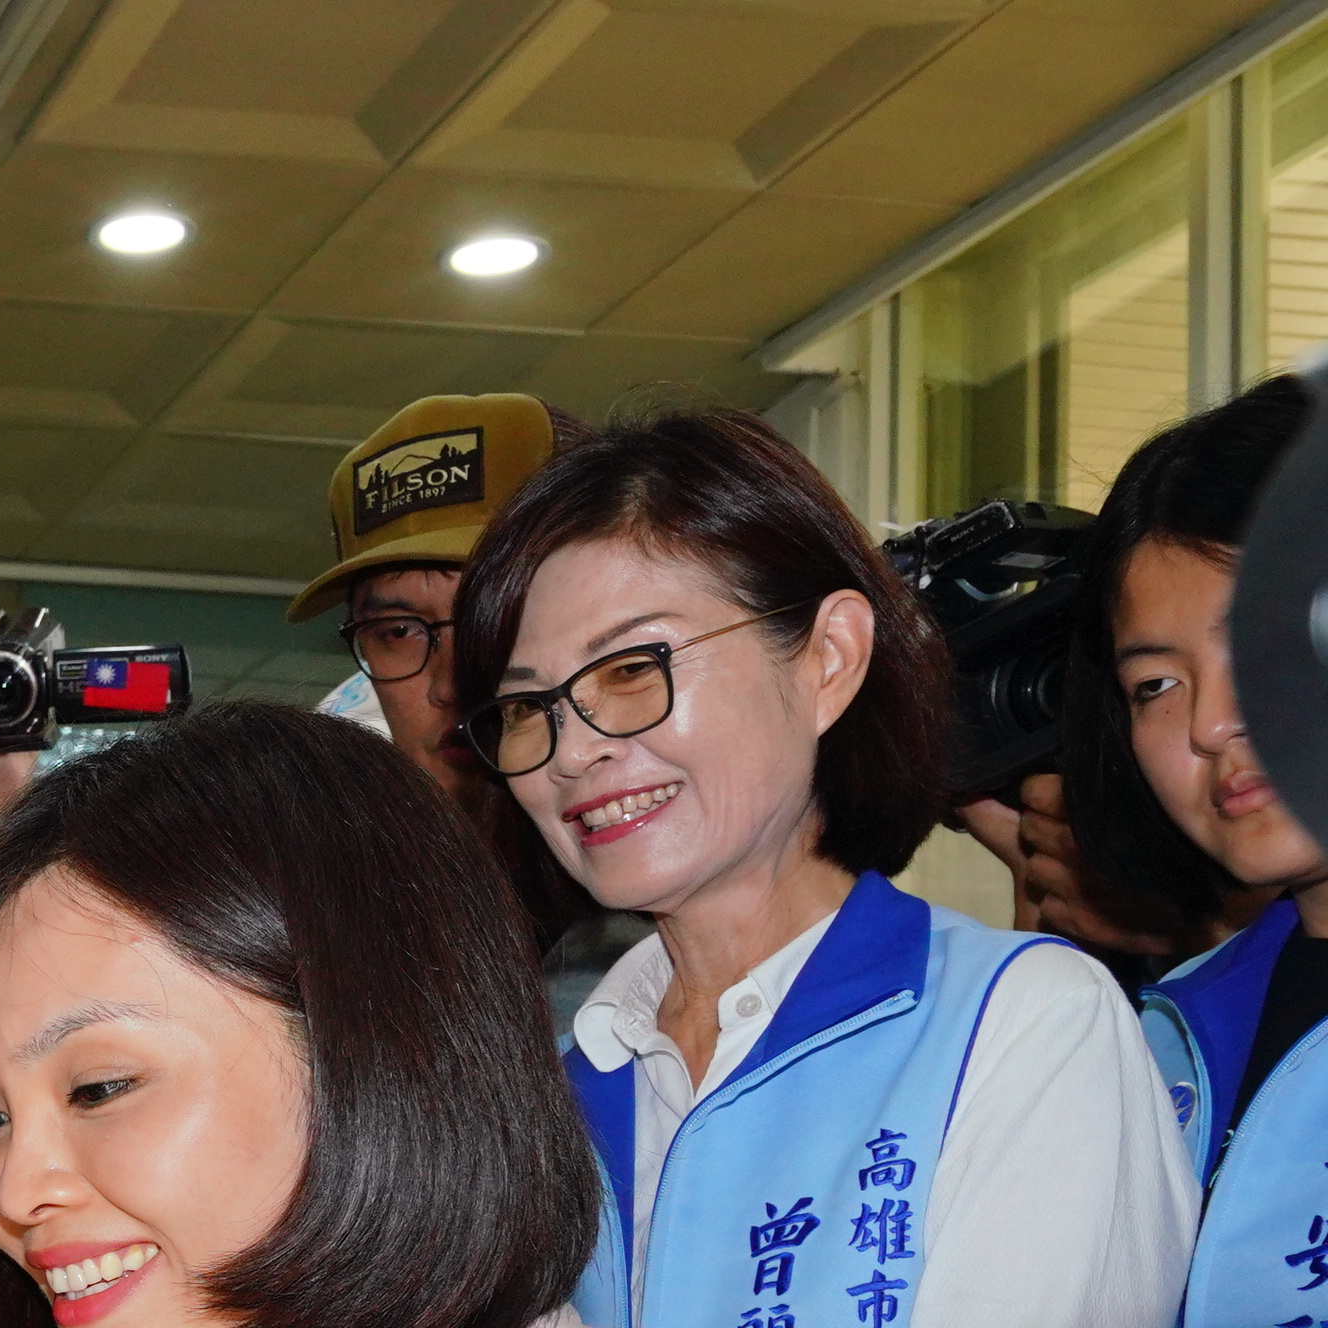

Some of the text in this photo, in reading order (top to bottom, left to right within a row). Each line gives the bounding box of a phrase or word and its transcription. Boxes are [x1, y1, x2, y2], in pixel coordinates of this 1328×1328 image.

[365, 464, 471, 510] FILSON
[381, 486, 446, 514] SINCE 1897
[134, 654, 169, 663] SONY
